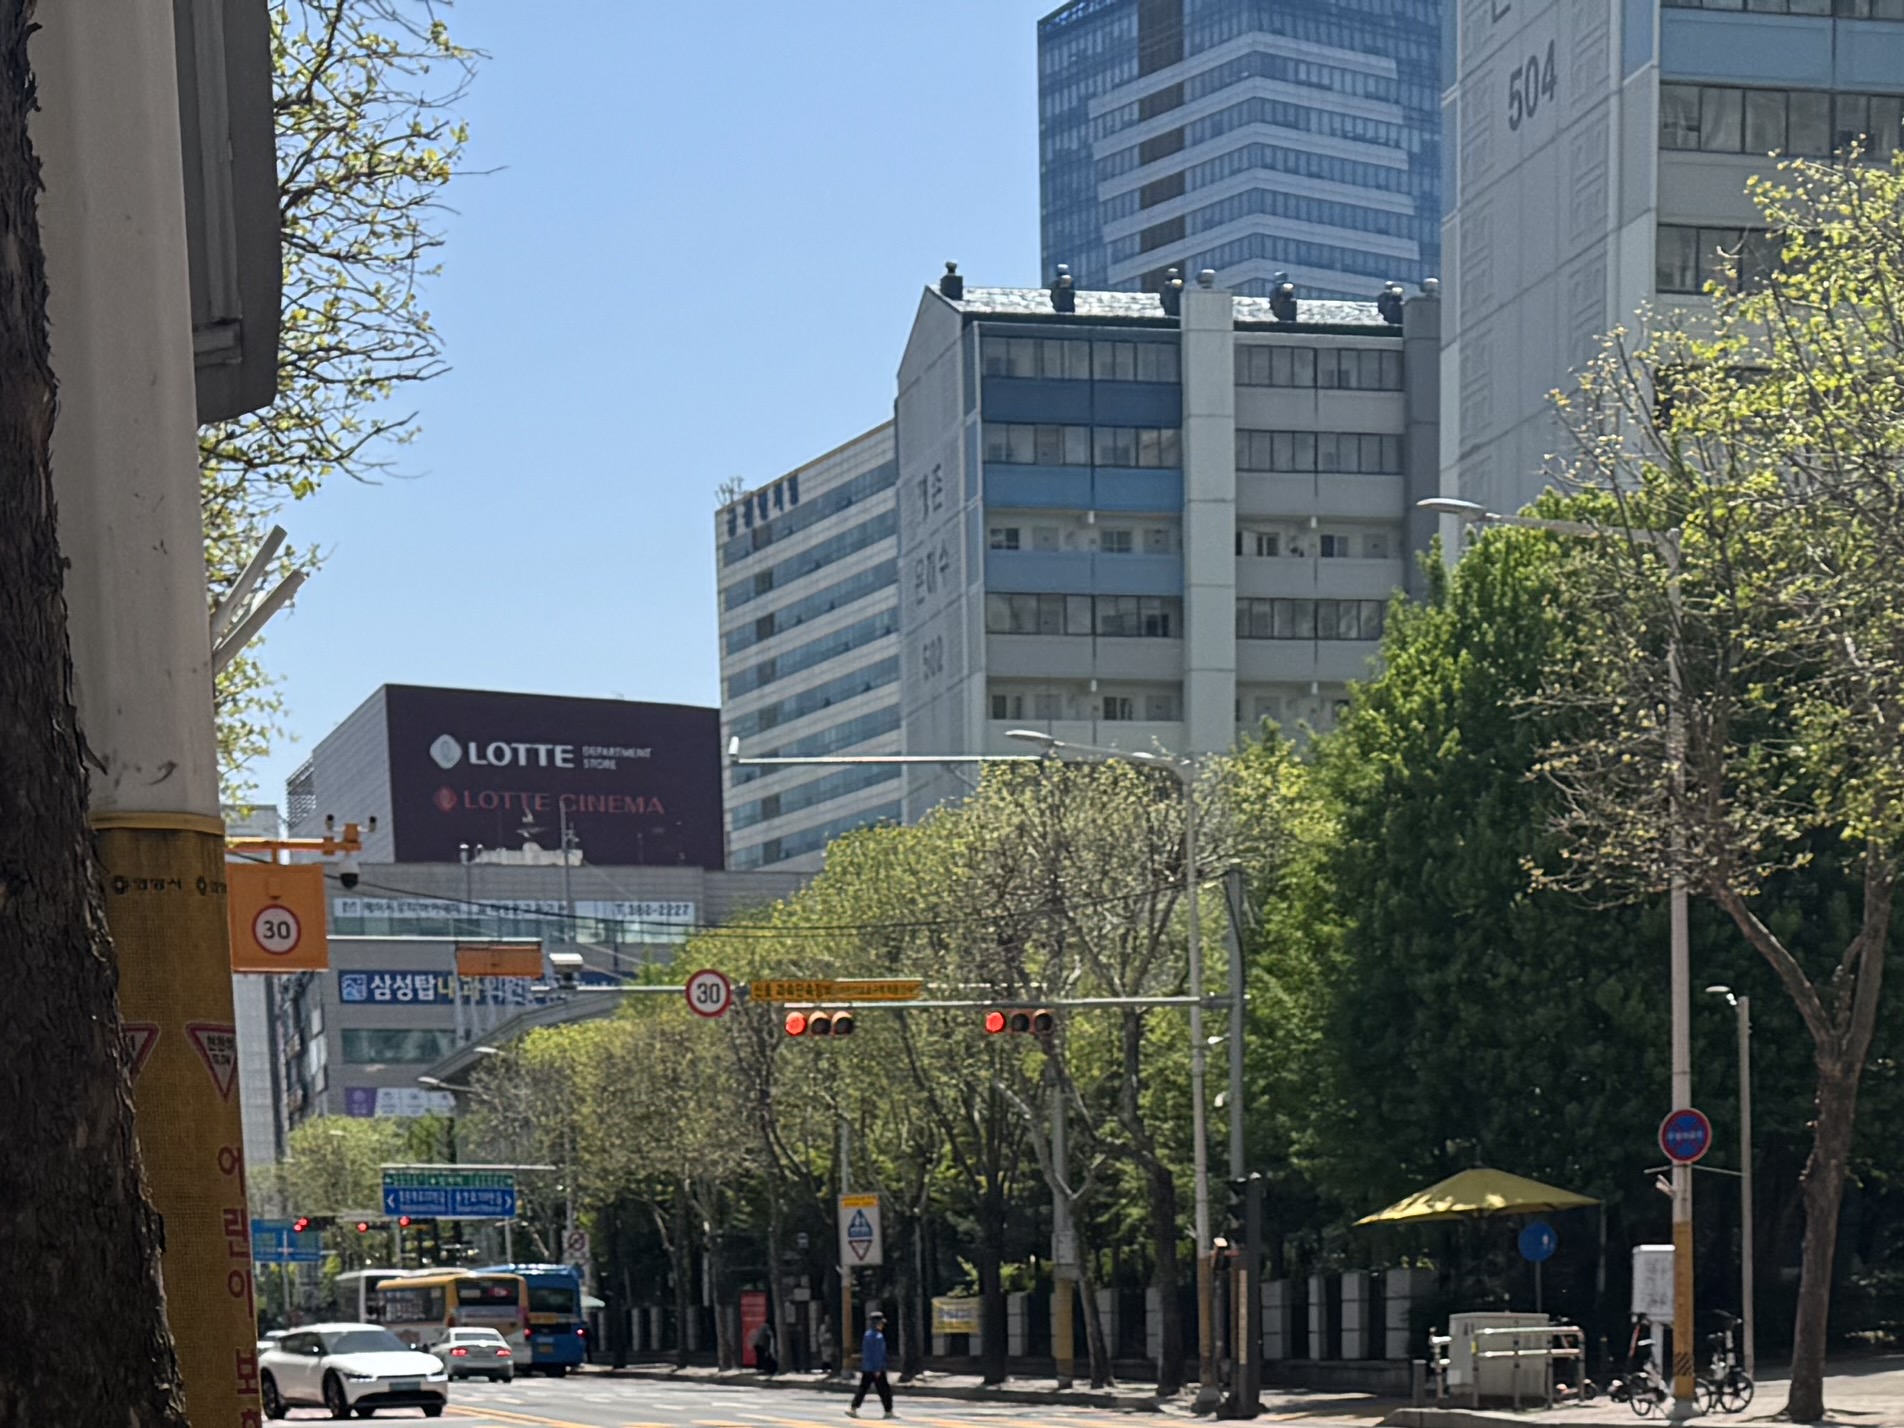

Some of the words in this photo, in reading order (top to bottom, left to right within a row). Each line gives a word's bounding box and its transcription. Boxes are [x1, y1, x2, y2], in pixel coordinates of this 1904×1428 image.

[1508, 39, 1558, 131] 504
[468, 741, 575, 768] LOTTE
[582, 744, 651, 759] DEPARTMENT
[583, 757, 616, 770] STORE
[464, 790, 549, 812] LOTTE
[559, 793, 665, 815] CINEMA
[263, 920, 291, 940] 30
[696, 983, 720, 1004] 30
[218, 1145, 253, 1319] 어린이
